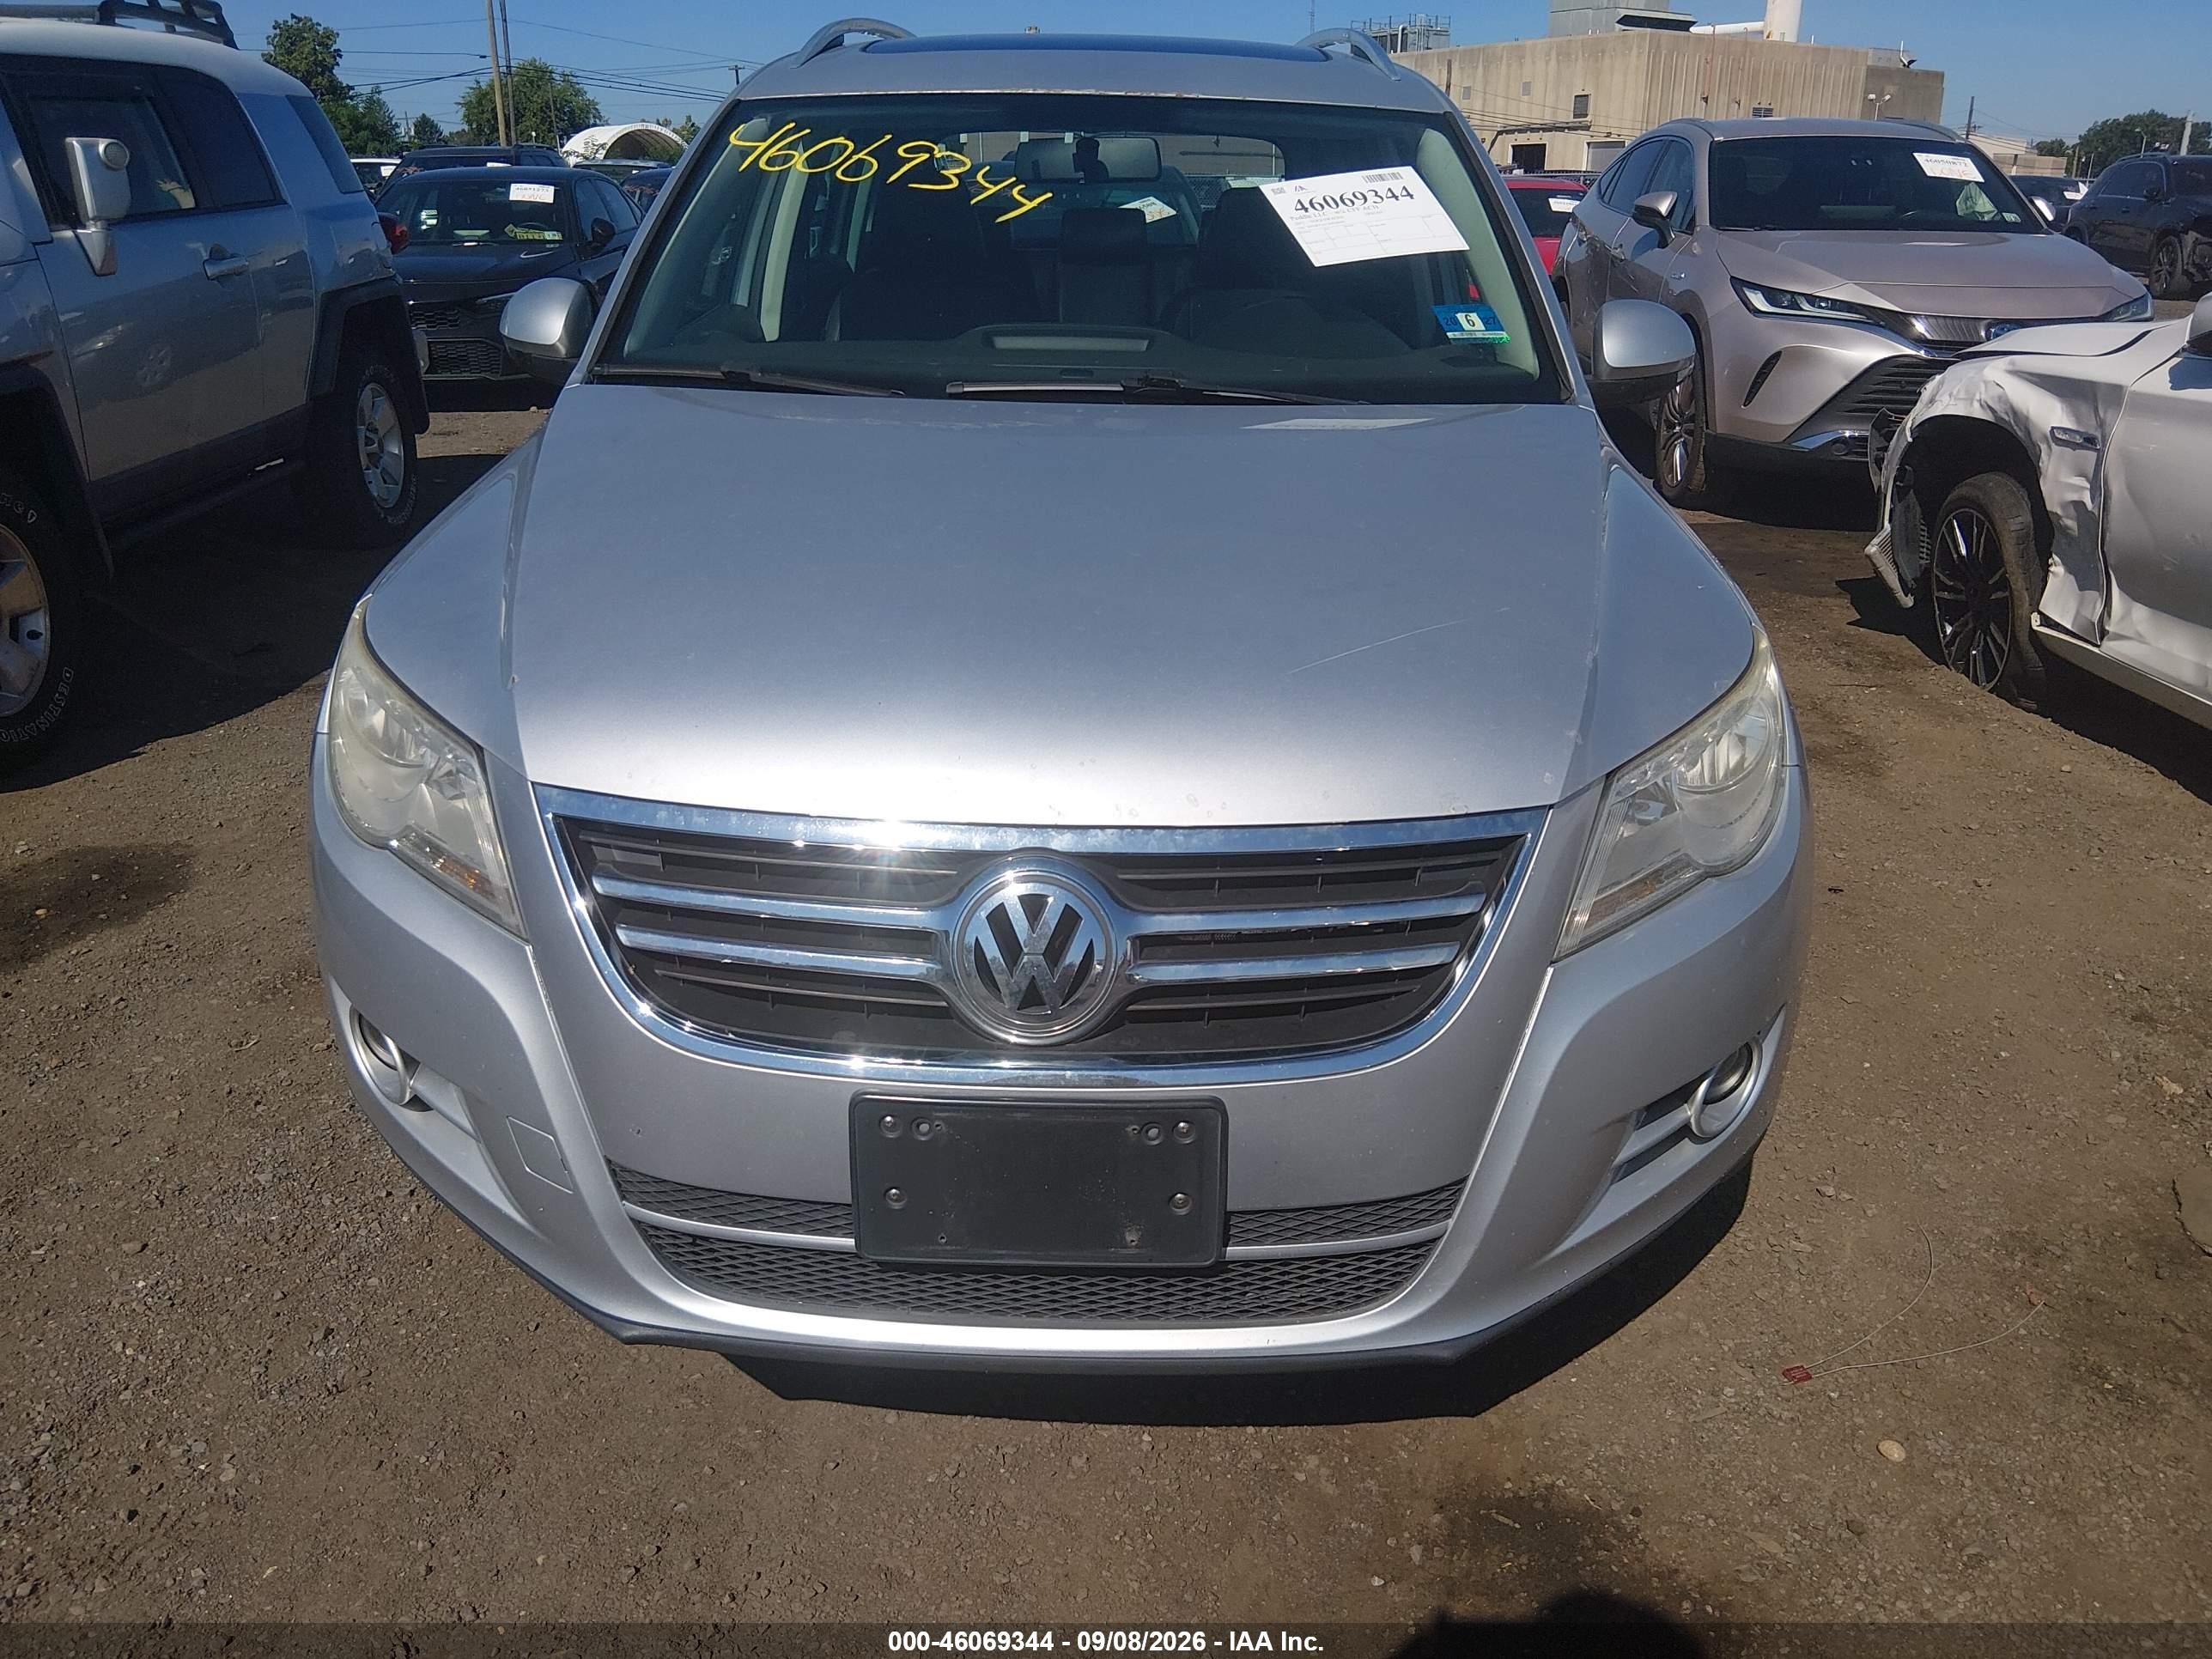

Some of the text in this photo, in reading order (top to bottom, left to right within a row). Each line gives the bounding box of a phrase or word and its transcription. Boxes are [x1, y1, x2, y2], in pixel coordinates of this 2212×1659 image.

[729, 121, 1054, 223] 46069344
[1294, 185, 1414, 213] 46069344
[1464, 313, 1476, 327] 6
[1482, 316, 1496, 325] 27
